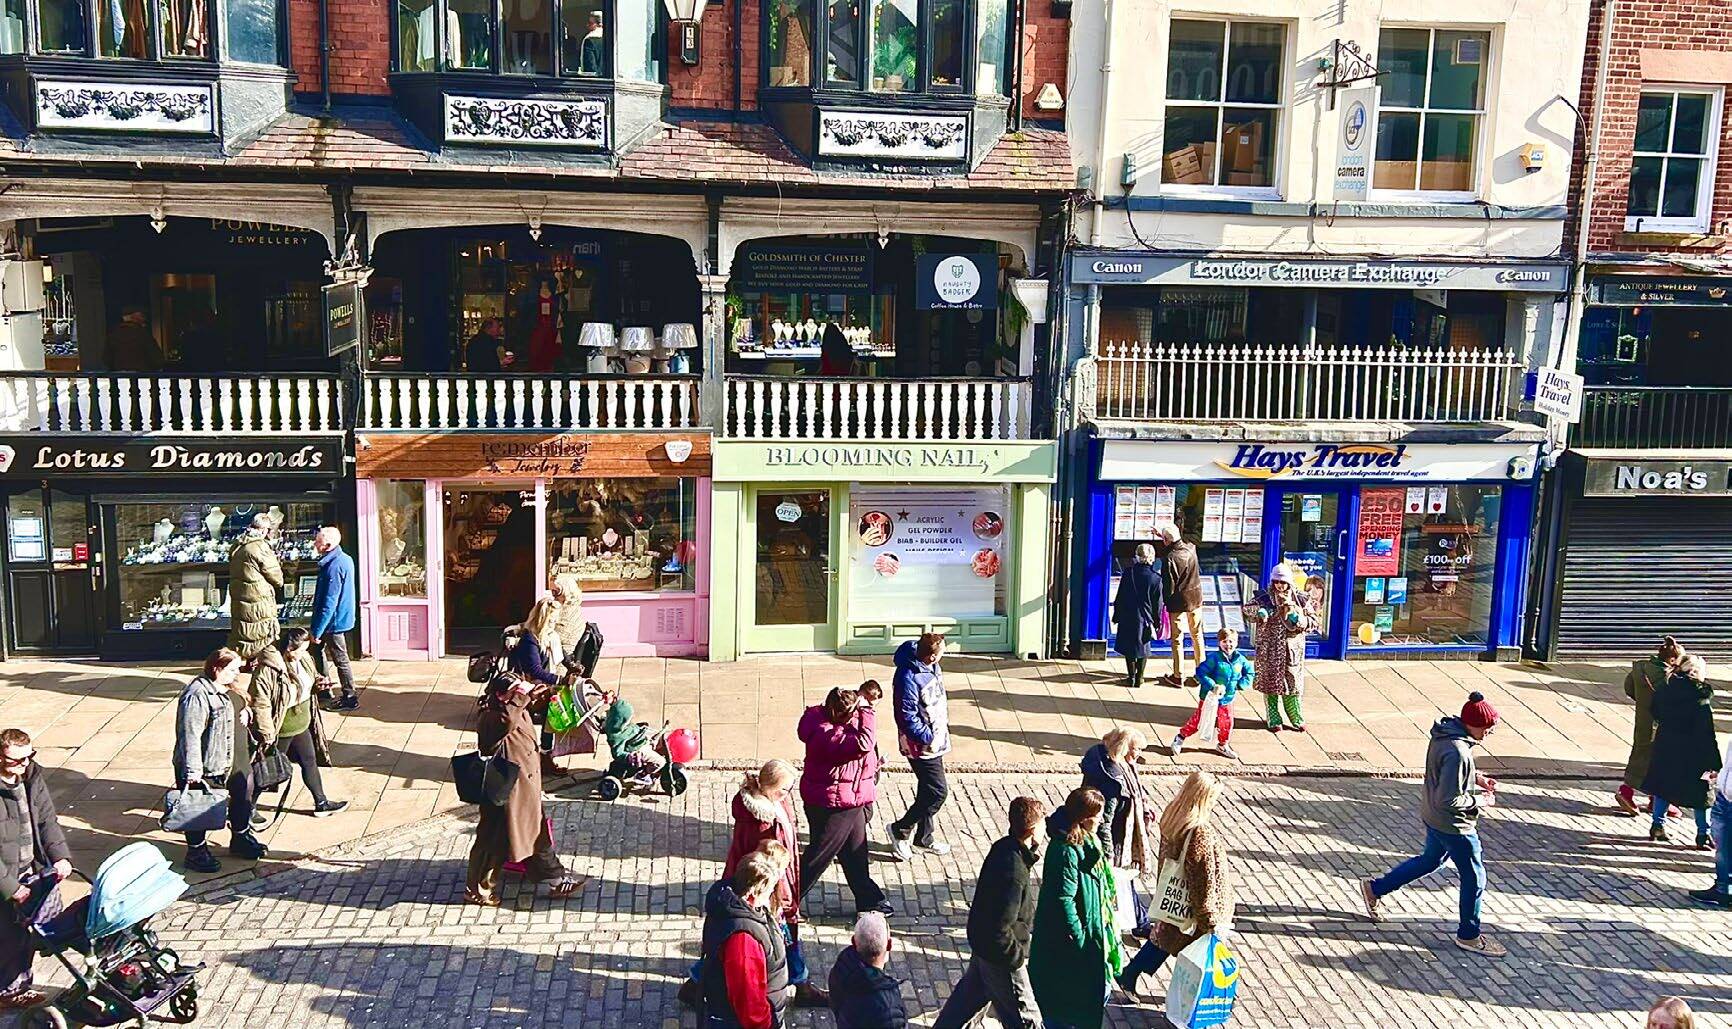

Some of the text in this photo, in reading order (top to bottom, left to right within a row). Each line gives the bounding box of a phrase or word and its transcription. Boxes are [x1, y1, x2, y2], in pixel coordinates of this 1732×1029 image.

[1337, 166, 1365, 177] camera
[229, 236, 308, 245] JEWELLERY
[748, 251, 866, 263] GOLDSMITH OF CHESTER
[1092, 260, 1142, 273] Canon
[1193, 260, 1448, 287] London Camera Exchange
[1497, 269, 1551, 283] Canon
[943, 288, 971, 296] BADGER
[1619, 283, 1697, 291] ANTIQUE JEWELLERY
[1640, 293, 1675, 301] & SILVER
[330, 303, 354, 321] POWELLS
[1545, 372, 1571, 390] Hays
[1540, 385, 1572, 406] Travel
[33, 446, 323, 468] Lotus Diamonds
[765, 448, 912, 467] BLOOMING
[1229, 445, 1407, 473] Hays Travel
[1327, 470, 1350, 478] largest
[1616, 466, 1708, 489] Noa's
[41, 478, 48, 489] 3
[1361, 496, 1402, 513] £50
[777, 506, 799, 518] OPEN
[916, 516, 945, 525] ACRYLIC
[1360, 513, 1402, 525] FREE
[1359, 531, 1400, 540] MONEY
[1455, 554, 1471, 564] off
[1169, 876, 1181, 886] MY
[1165, 886, 1183, 900] BAG
